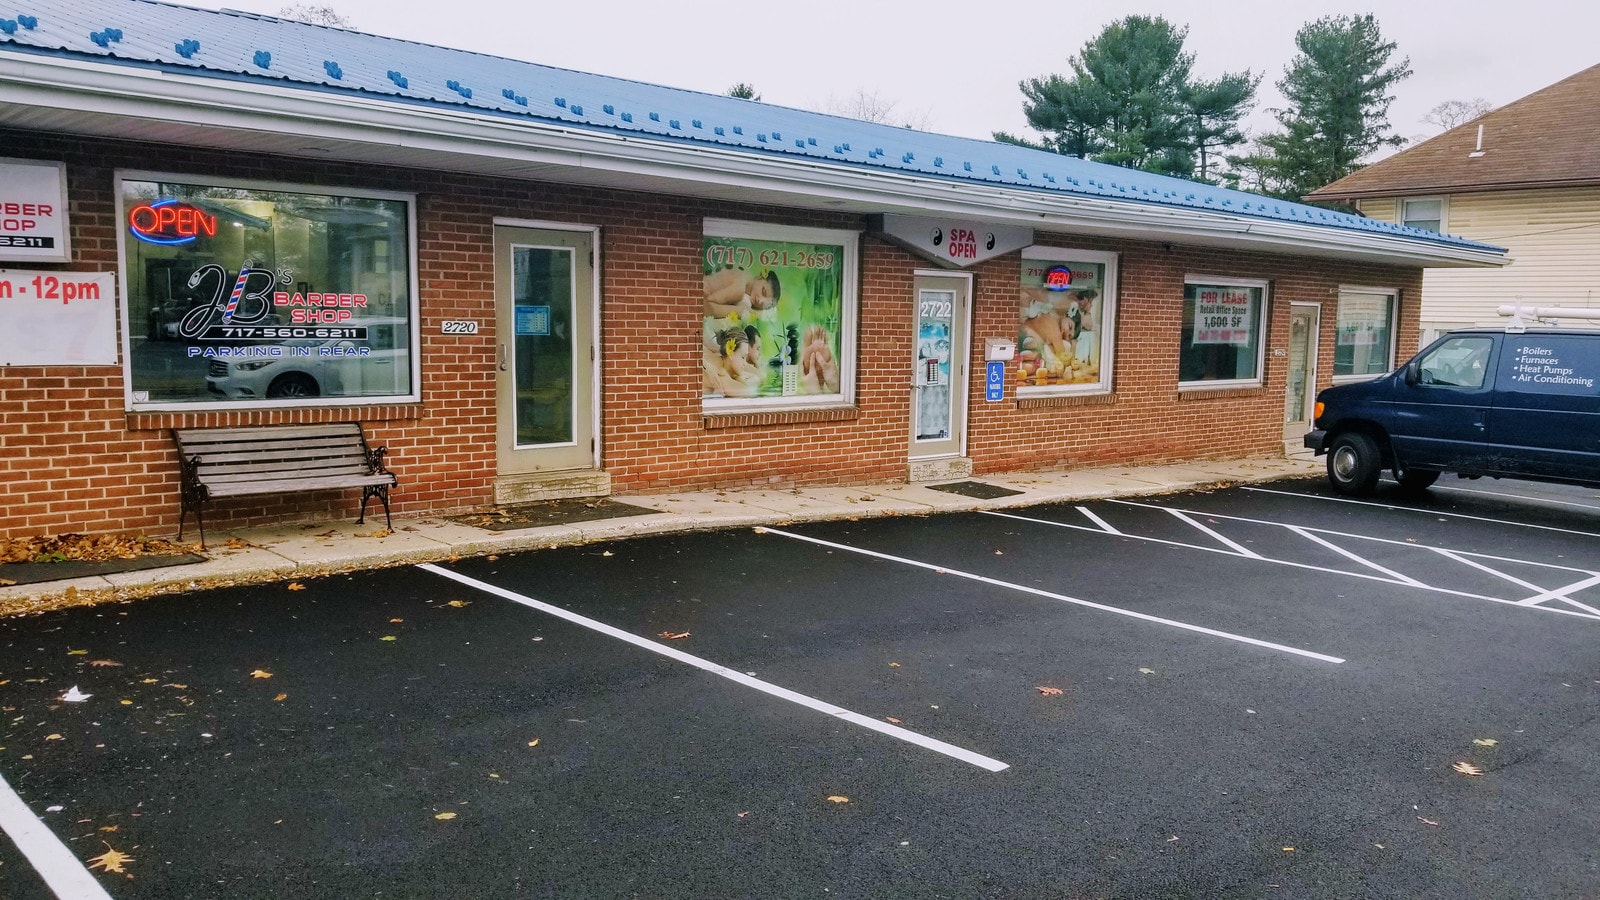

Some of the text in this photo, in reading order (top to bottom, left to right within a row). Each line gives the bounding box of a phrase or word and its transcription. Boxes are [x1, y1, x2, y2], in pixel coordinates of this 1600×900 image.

[0, 202, 53, 217] BER
[130, 205, 217, 237] OPEN
[950, 229, 976, 243] SPA
[707, 245, 835, 269] (717) 621-2659
[949, 242, 977, 258] OPEN
[1047, 271, 1071, 286] OPEN
[31, 275, 100, 304] 12pm
[273, 292, 368, 308] BARBER
[1200, 291, 1248, 305] FOR LEASE
[291, 308, 353, 324] SHOP
[920, 302, 952, 318] 2722
[1216, 305, 1231, 315] Office
[1232, 305, 1247, 317] Space
[444, 321, 476, 333] 2720
[1203, 316, 1243, 330] 1,600 SF
[221, 327, 358, 339] 717-560-6211
[188, 346, 371, 358] PARKING IN REAR
[1522, 346, 1553, 356] Boilers
[1520, 355, 1559, 365] Furnaces
[1519, 364, 1574, 376] Heat Pumps
[1517, 373, 1594, 387] Air Conditioning
